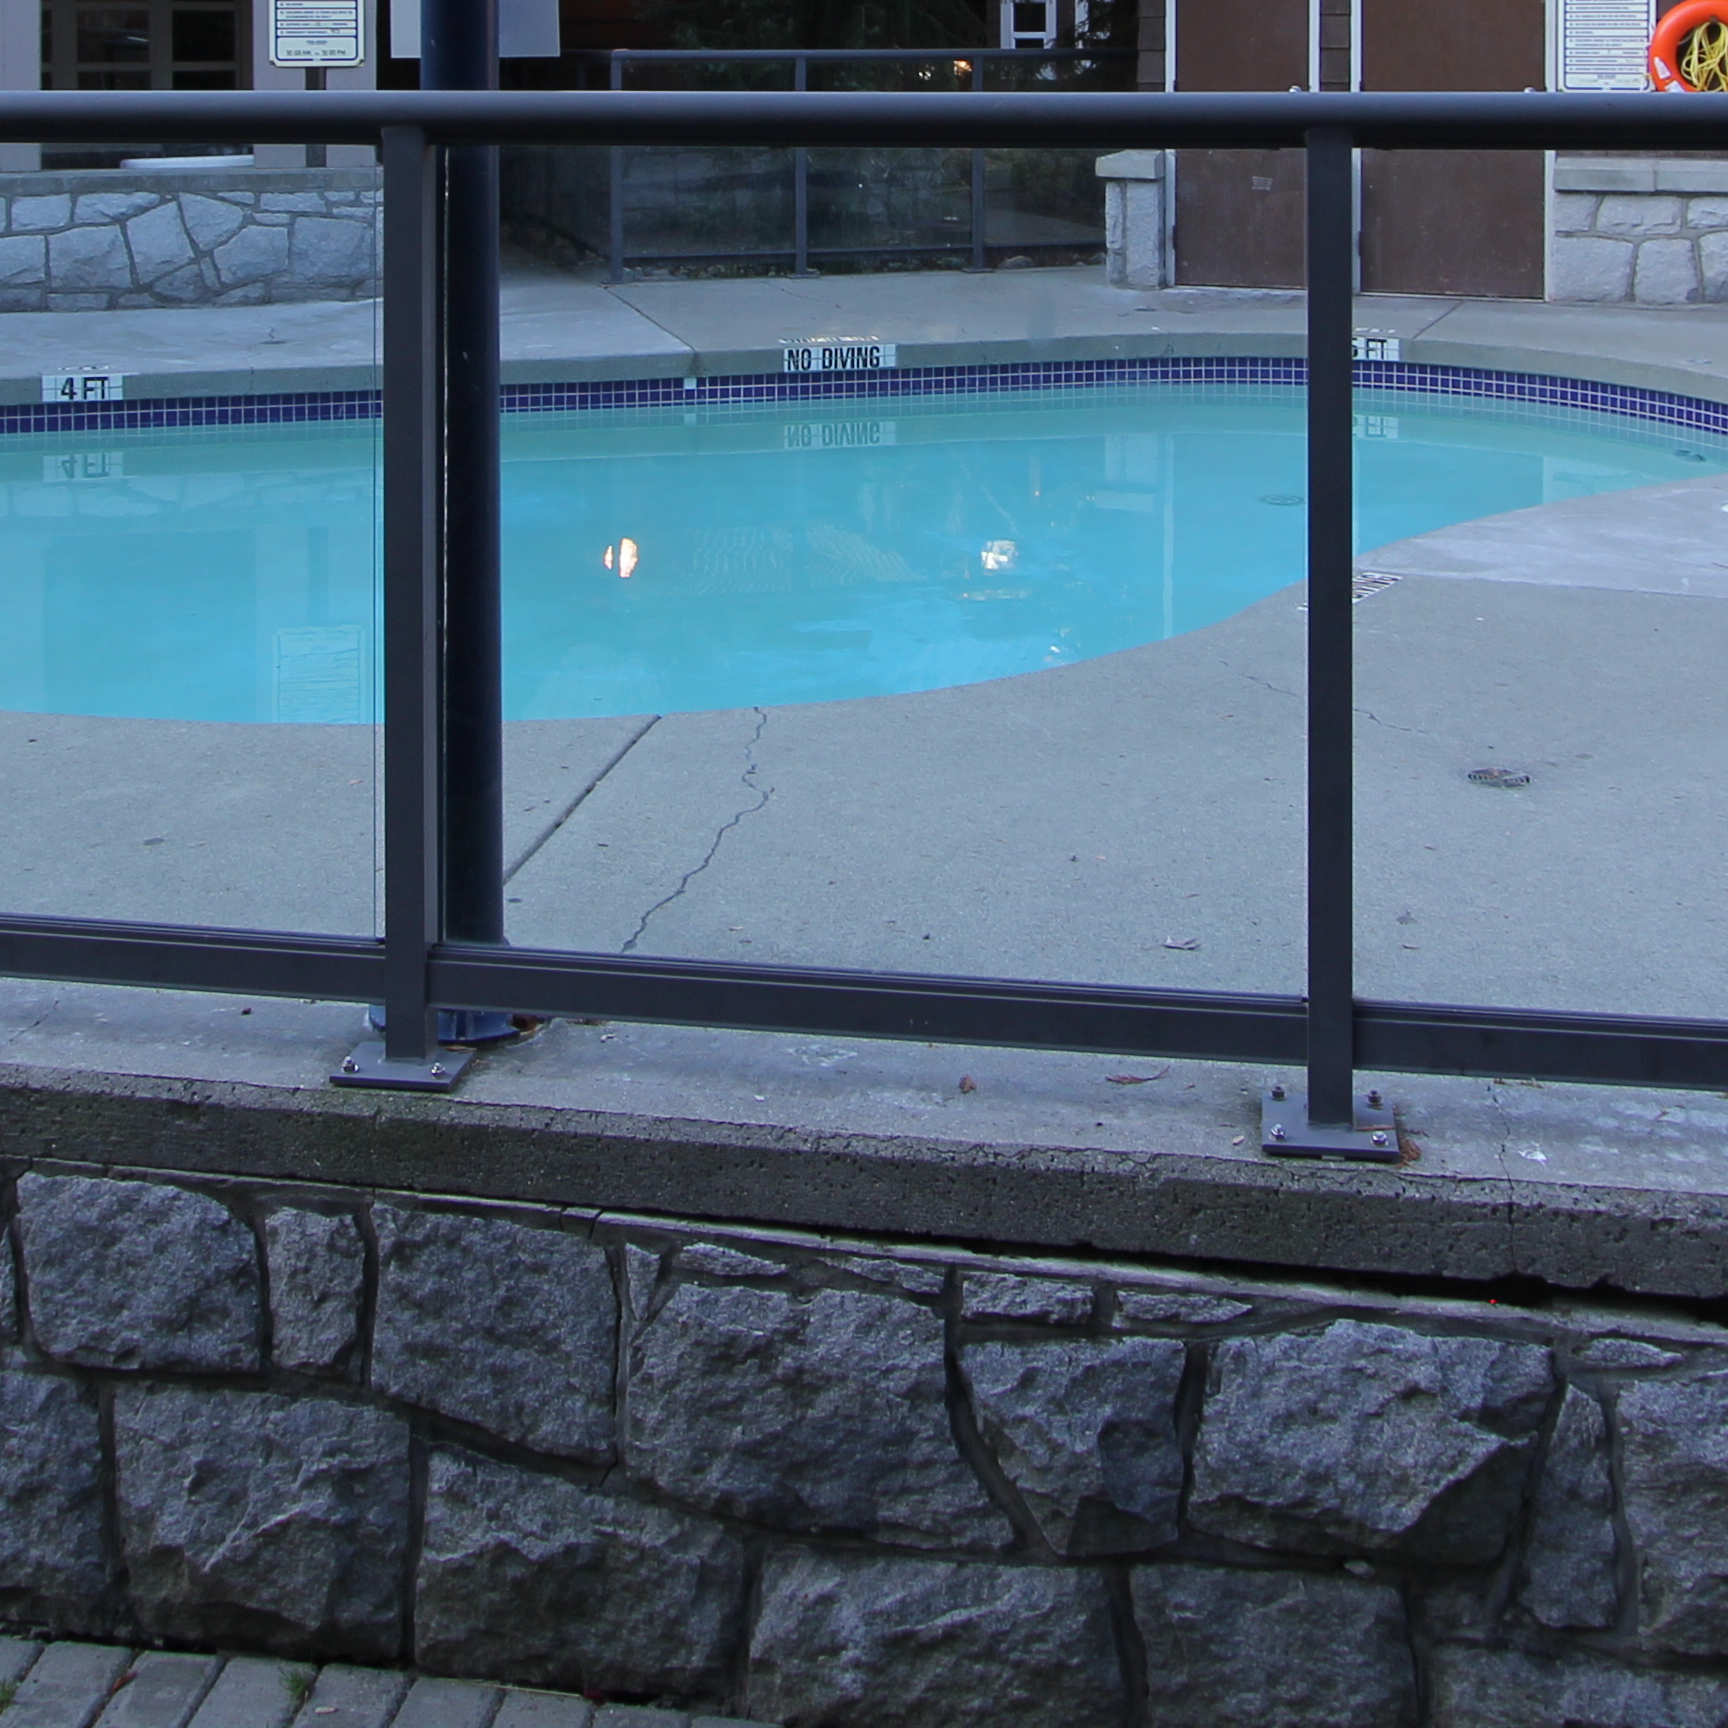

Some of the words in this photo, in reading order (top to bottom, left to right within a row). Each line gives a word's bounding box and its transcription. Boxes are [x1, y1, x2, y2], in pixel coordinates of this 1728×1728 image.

[787, 348, 812, 371] NO
[822, 346, 880, 370] DIVING
[1366, 338, 1387, 360] FT
[60, 376, 77, 400] 4
[83, 376, 109, 400] FT
